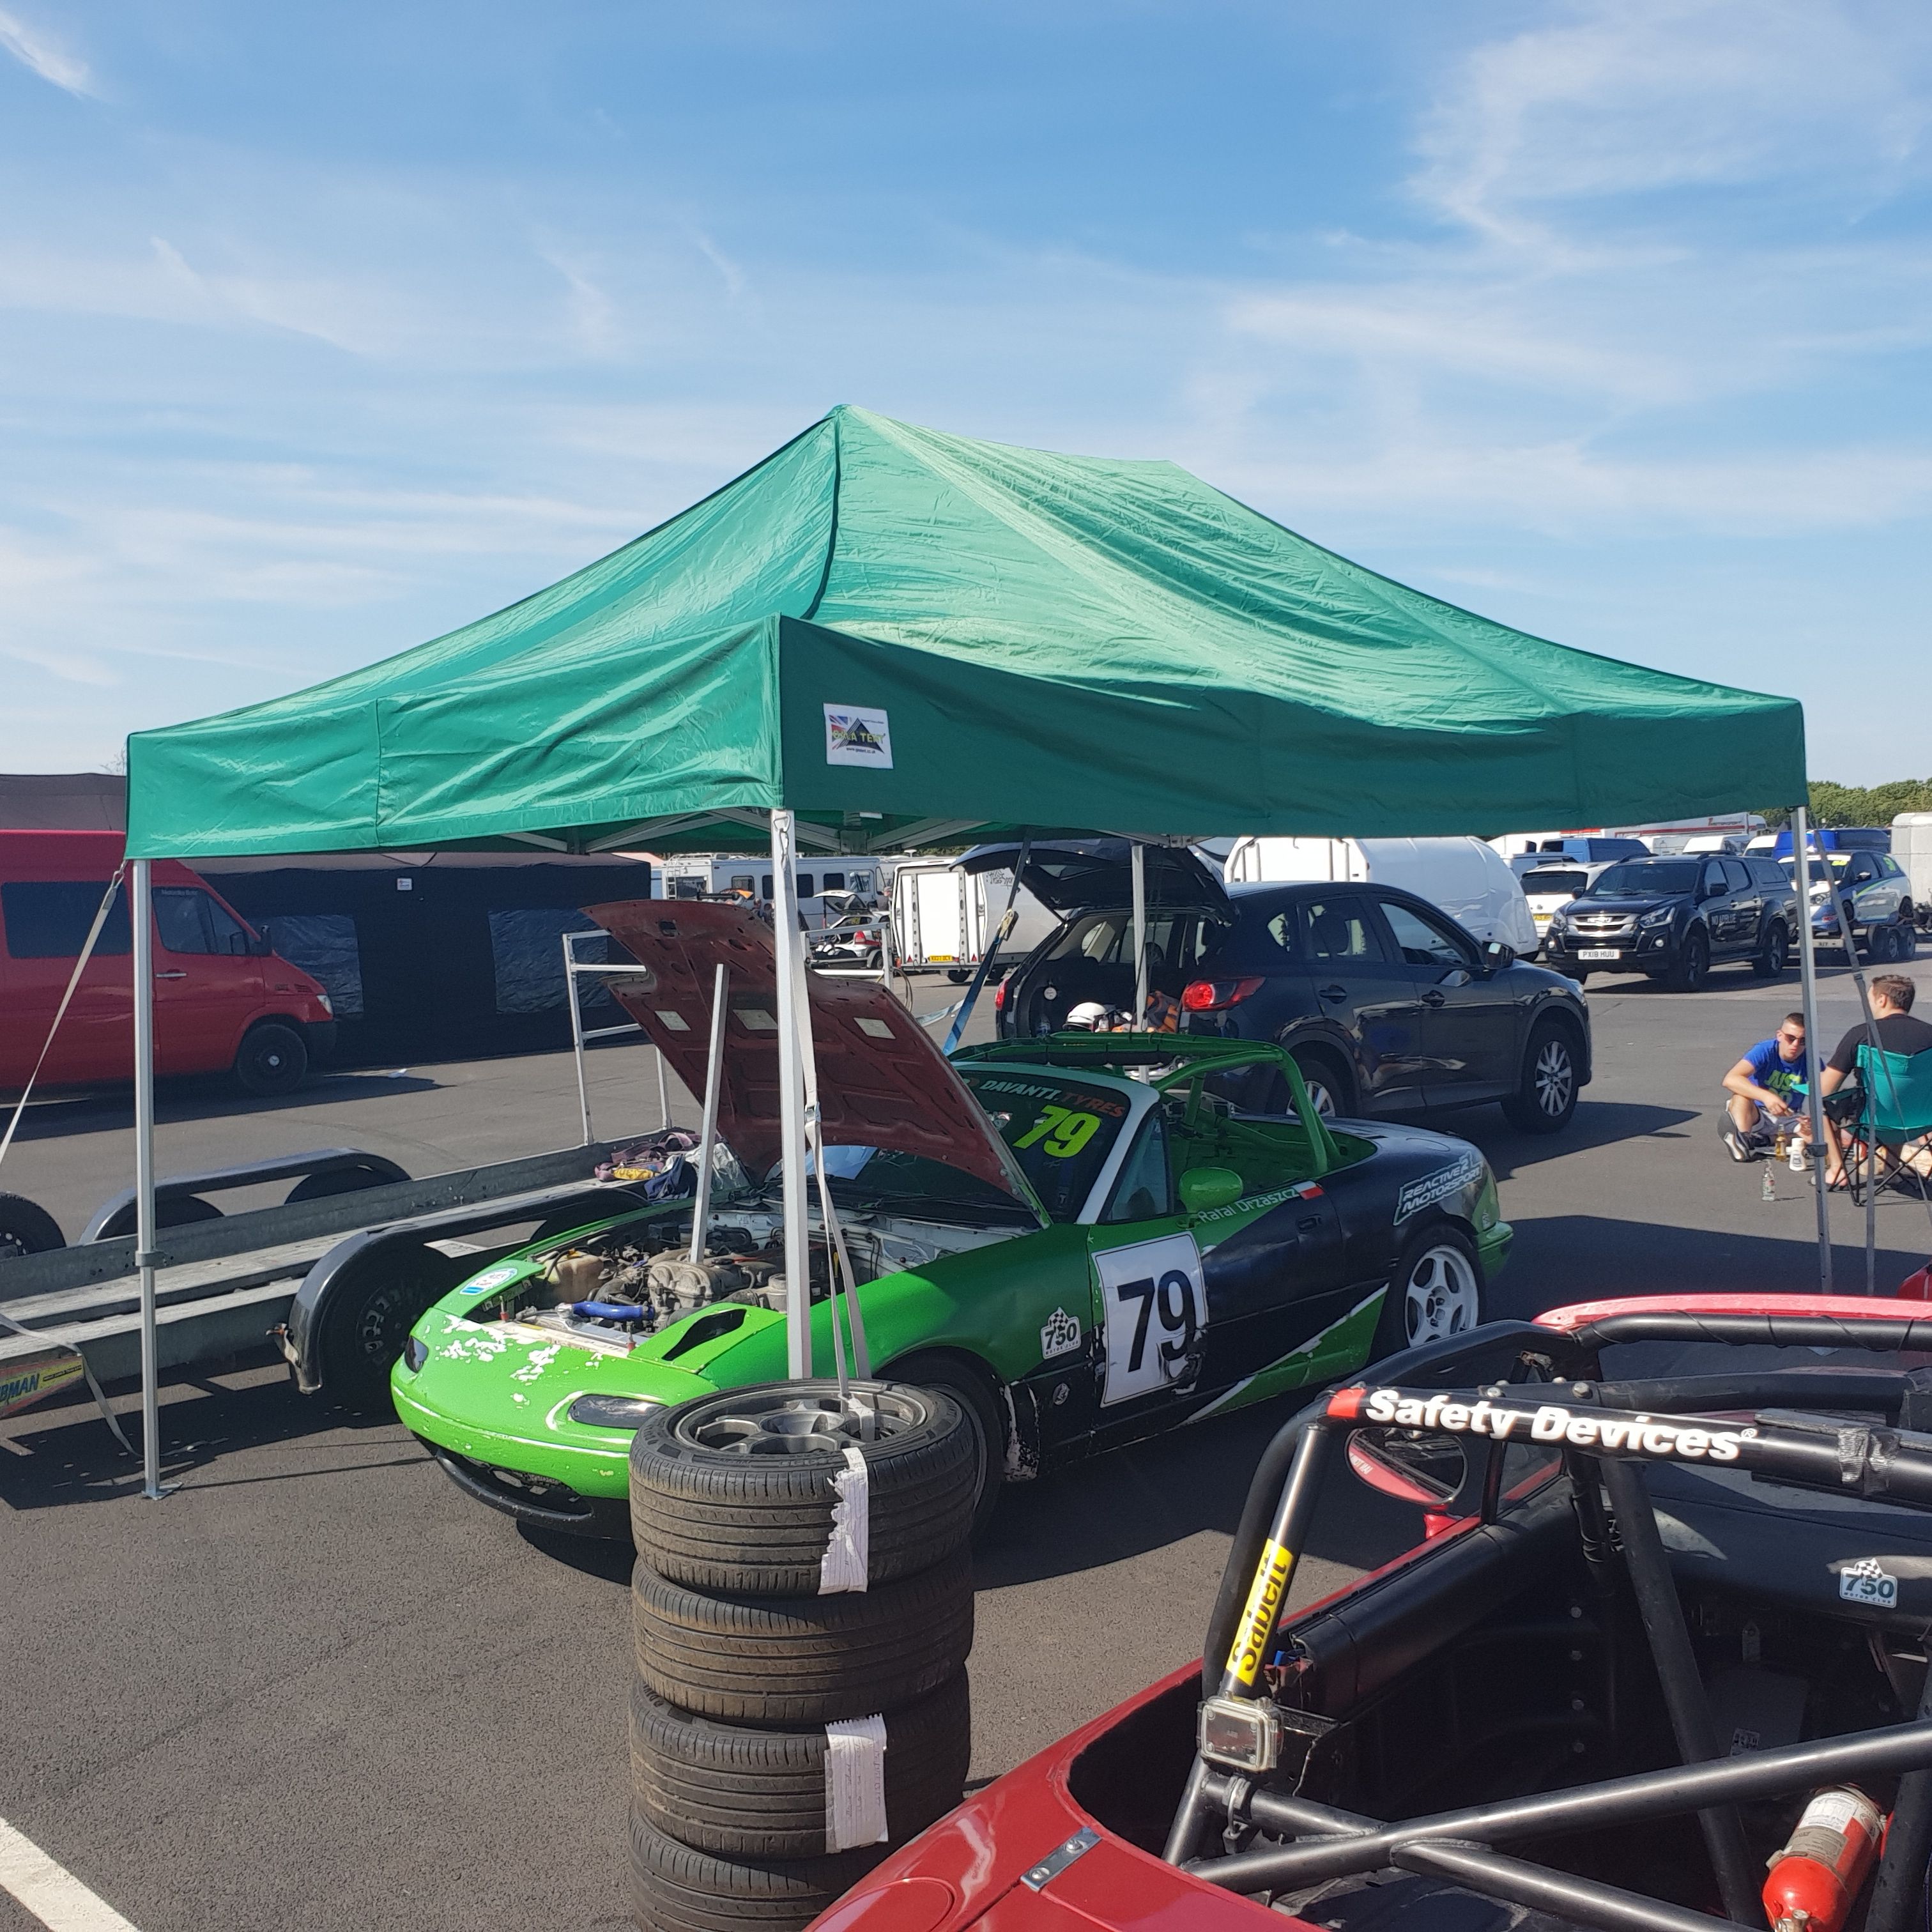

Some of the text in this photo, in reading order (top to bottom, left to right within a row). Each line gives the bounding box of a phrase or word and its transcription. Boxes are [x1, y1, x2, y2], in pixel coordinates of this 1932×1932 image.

[1062, 1092, 1125, 1118] TYRES
[1012, 1105, 1101, 1158] 79
[1402, 1167, 1480, 1213] MOTORSPORT
[1045, 1322, 1077, 1350] 750
[1117, 1269, 1197, 1373] 79
[1366, 1389, 1518, 1439] Safety
[1845, 1573, 1894, 1598] 750
